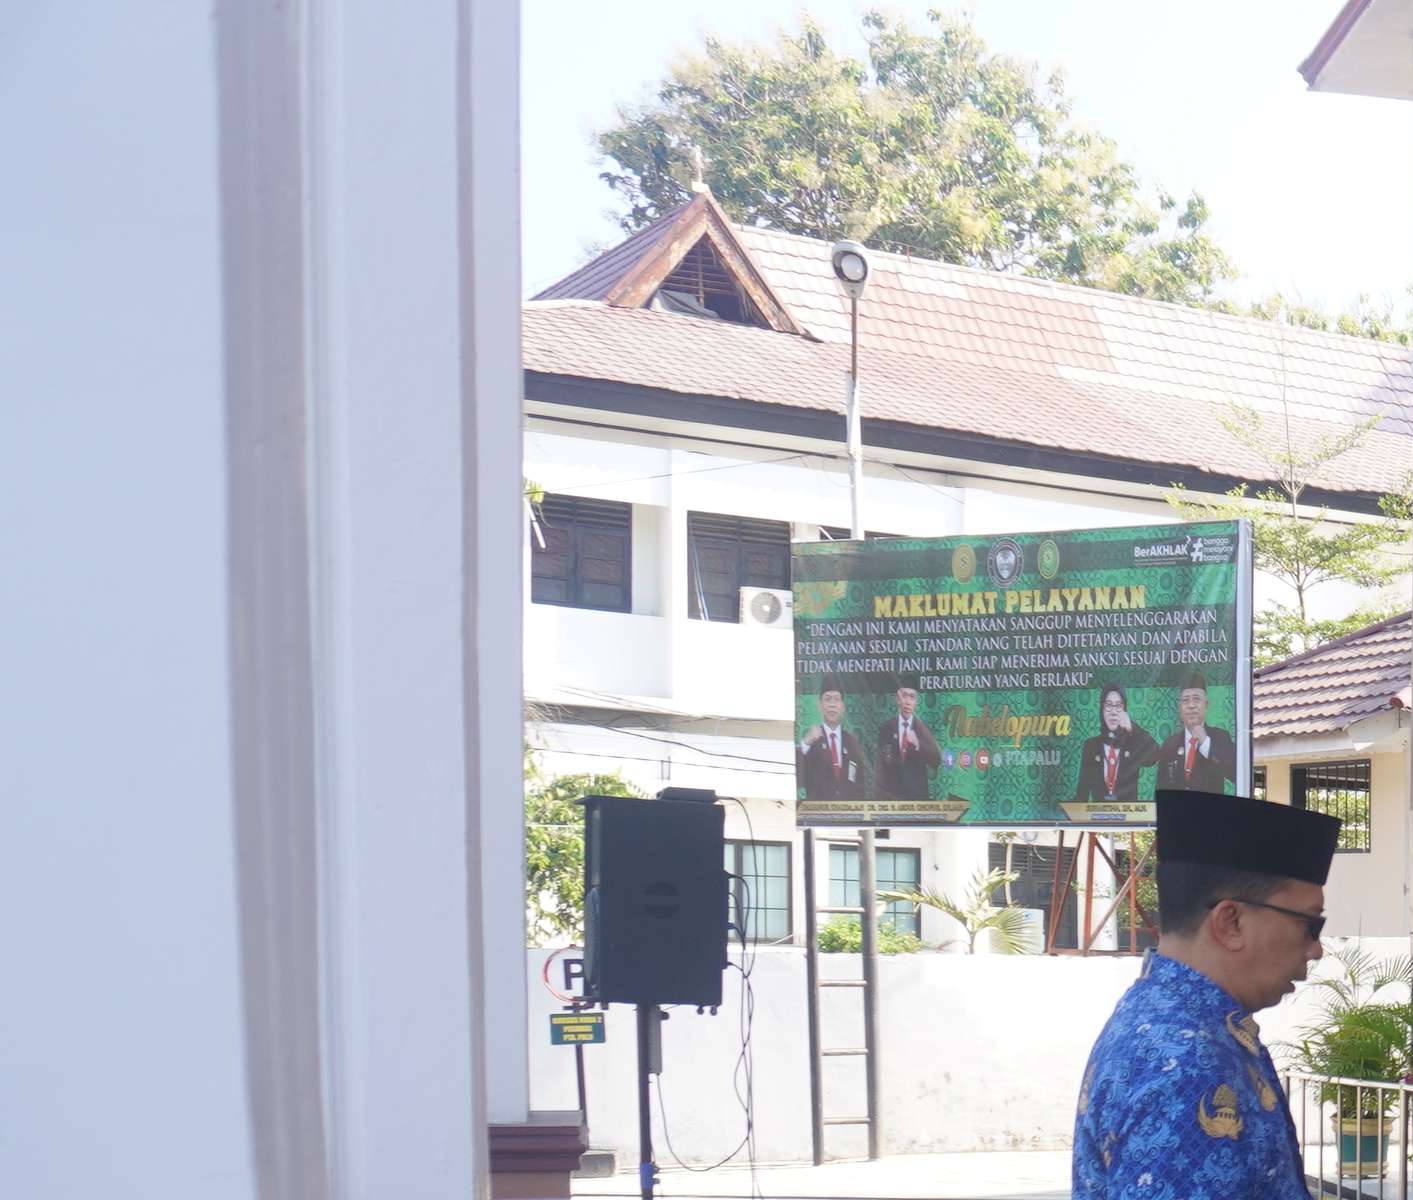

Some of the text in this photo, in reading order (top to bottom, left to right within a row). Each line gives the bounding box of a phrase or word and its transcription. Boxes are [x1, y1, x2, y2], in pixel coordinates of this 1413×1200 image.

[1134, 544, 1188, 557] BerAKHLAK
[874, 585, 1146, 618] MAKLUMAT PELAYANAN
[866, 621, 884, 635] INI
[888, 620, 920, 635] KAMI
[924, 618, 1006, 634] MENYATAKAN
[1010, 616, 1071, 631] SANGGUP
[1075, 609, 1217, 628] MENYELENGGARAKAN
[798, 628, 1227, 655] PELAYANAN SESUAI STANDAR YANG TELAH DITETAPKAN DAN APABILA
[797, 659, 832, 673] TIDAK
[837, 658, 895, 673] MENEPATI
[936, 656, 967, 671] KAMI
[972, 655, 998, 669] SIAP
[1000, 652, 1070, 669] MENERIMA
[1073, 651, 1119, 666] SANKSI
[1124, 650, 1165, 664] SESUAI
[1170, 647, 1228, 664] DENGAN
[920, 675, 995, 689] PERATURAN
[995, 673, 1029, 687] YANG
